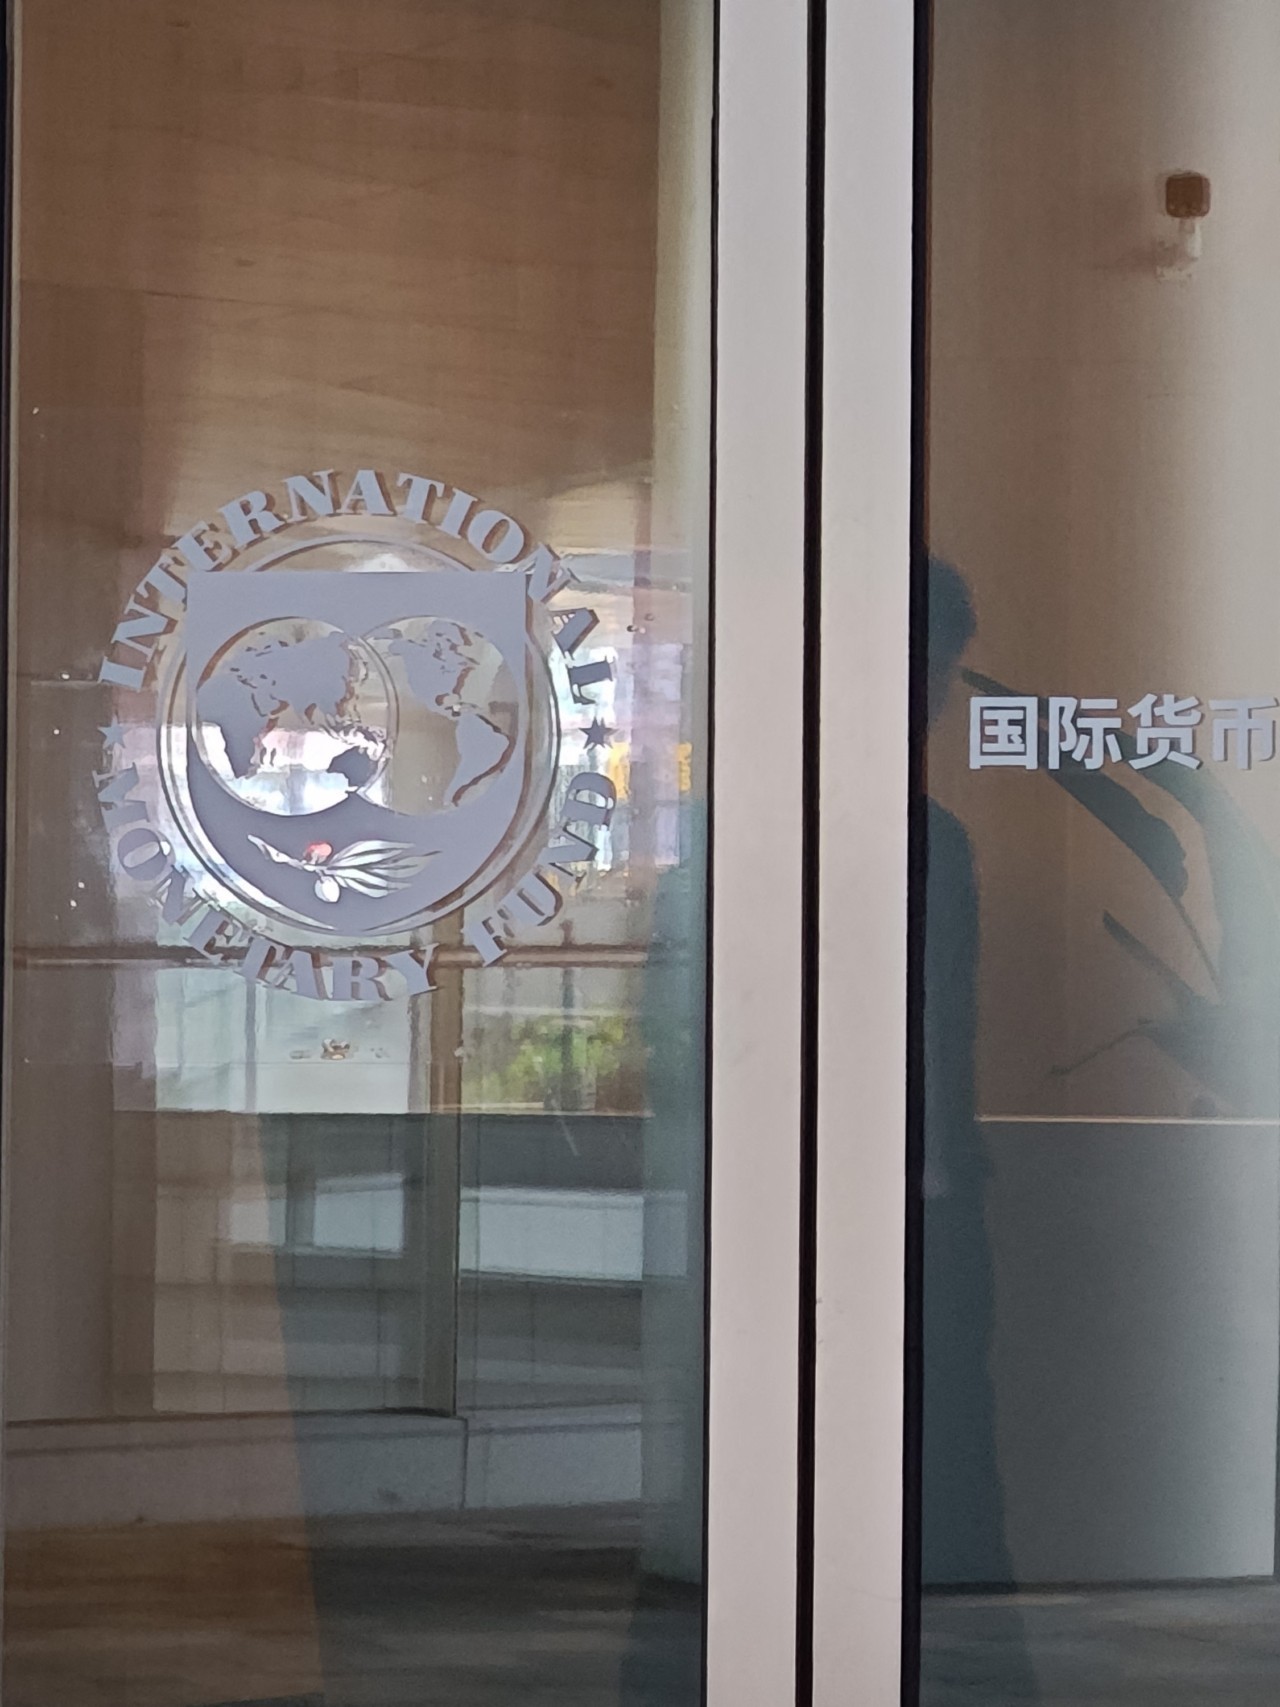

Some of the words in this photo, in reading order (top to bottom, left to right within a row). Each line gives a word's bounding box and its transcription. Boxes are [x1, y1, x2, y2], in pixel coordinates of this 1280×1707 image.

[99, 469, 617, 705] INTERNATIONAL
[92, 752, 439, 1001] MONETARY
[465, 771, 618, 966] FUND
